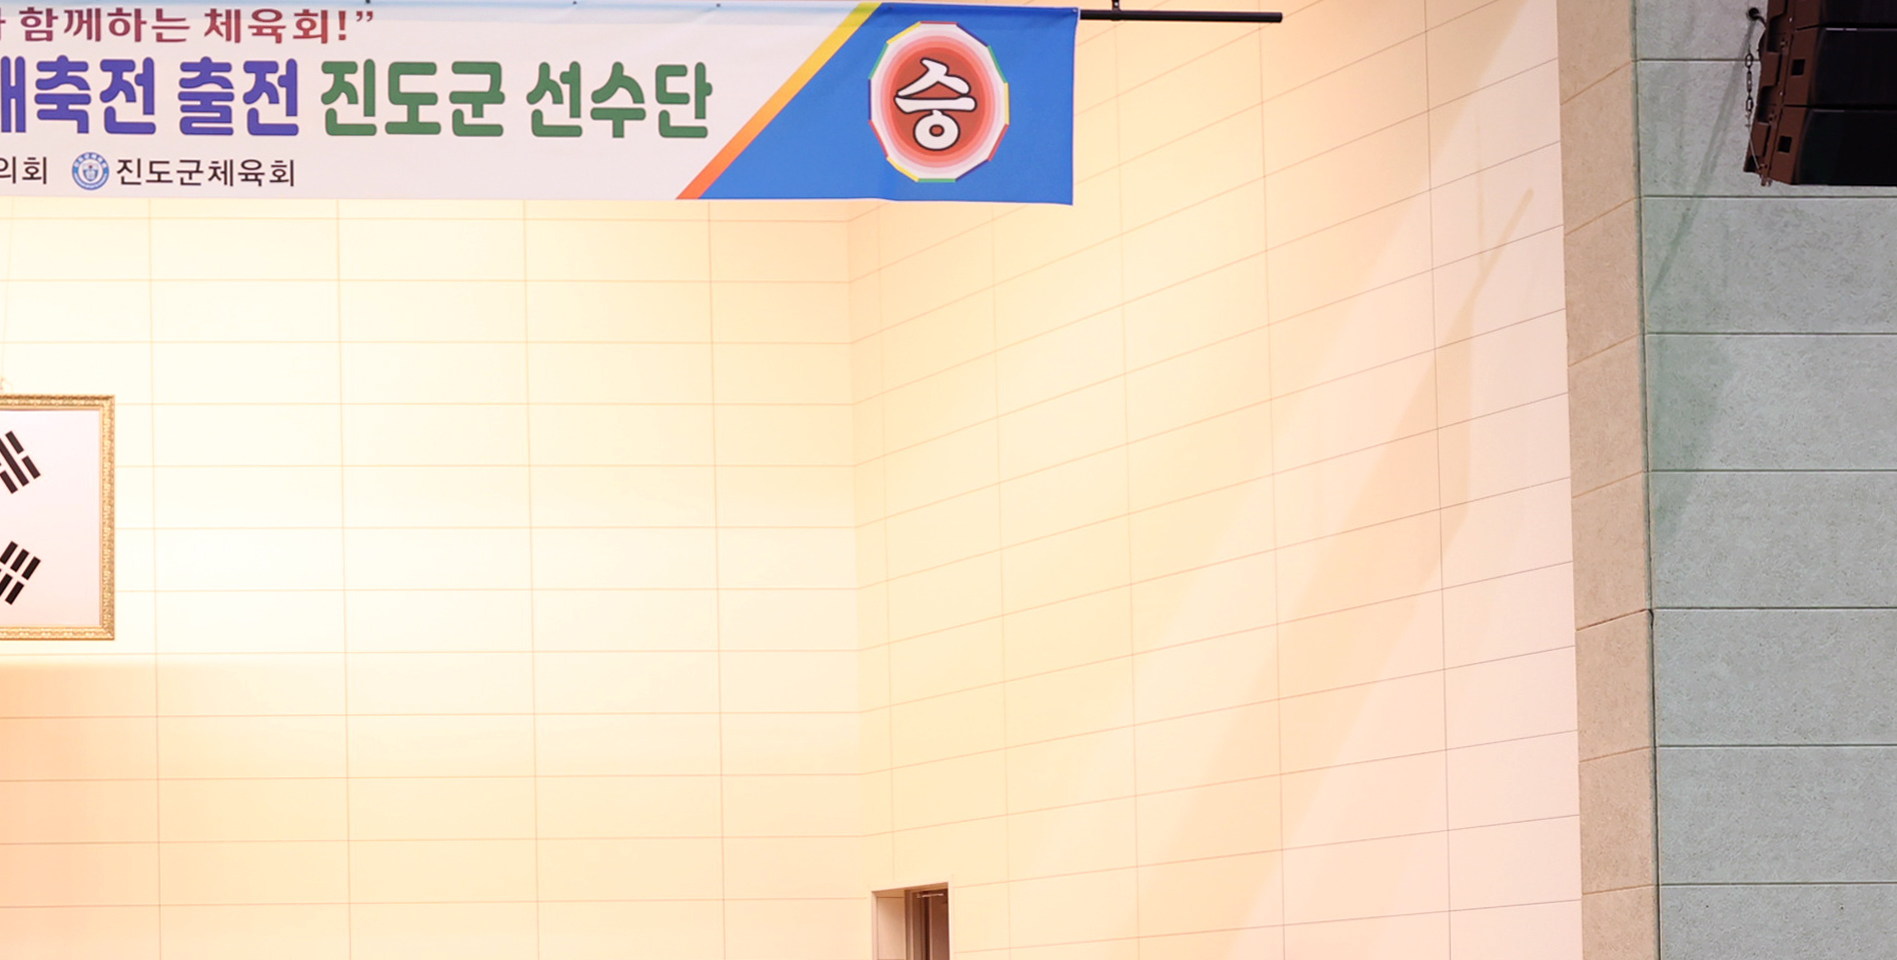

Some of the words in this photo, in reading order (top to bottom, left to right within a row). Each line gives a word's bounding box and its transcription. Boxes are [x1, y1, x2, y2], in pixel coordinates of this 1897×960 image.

[19, 6, 190, 43] 함께하는
[204, 8, 374, 44] 체육회!”
[177, 56, 300, 137] 출전
[320, 59, 506, 138] 진도군
[525, 60, 713, 139] 선수단
[893, 57, 977, 151] 승
[116, 157, 295, 188] 진도군체육회
